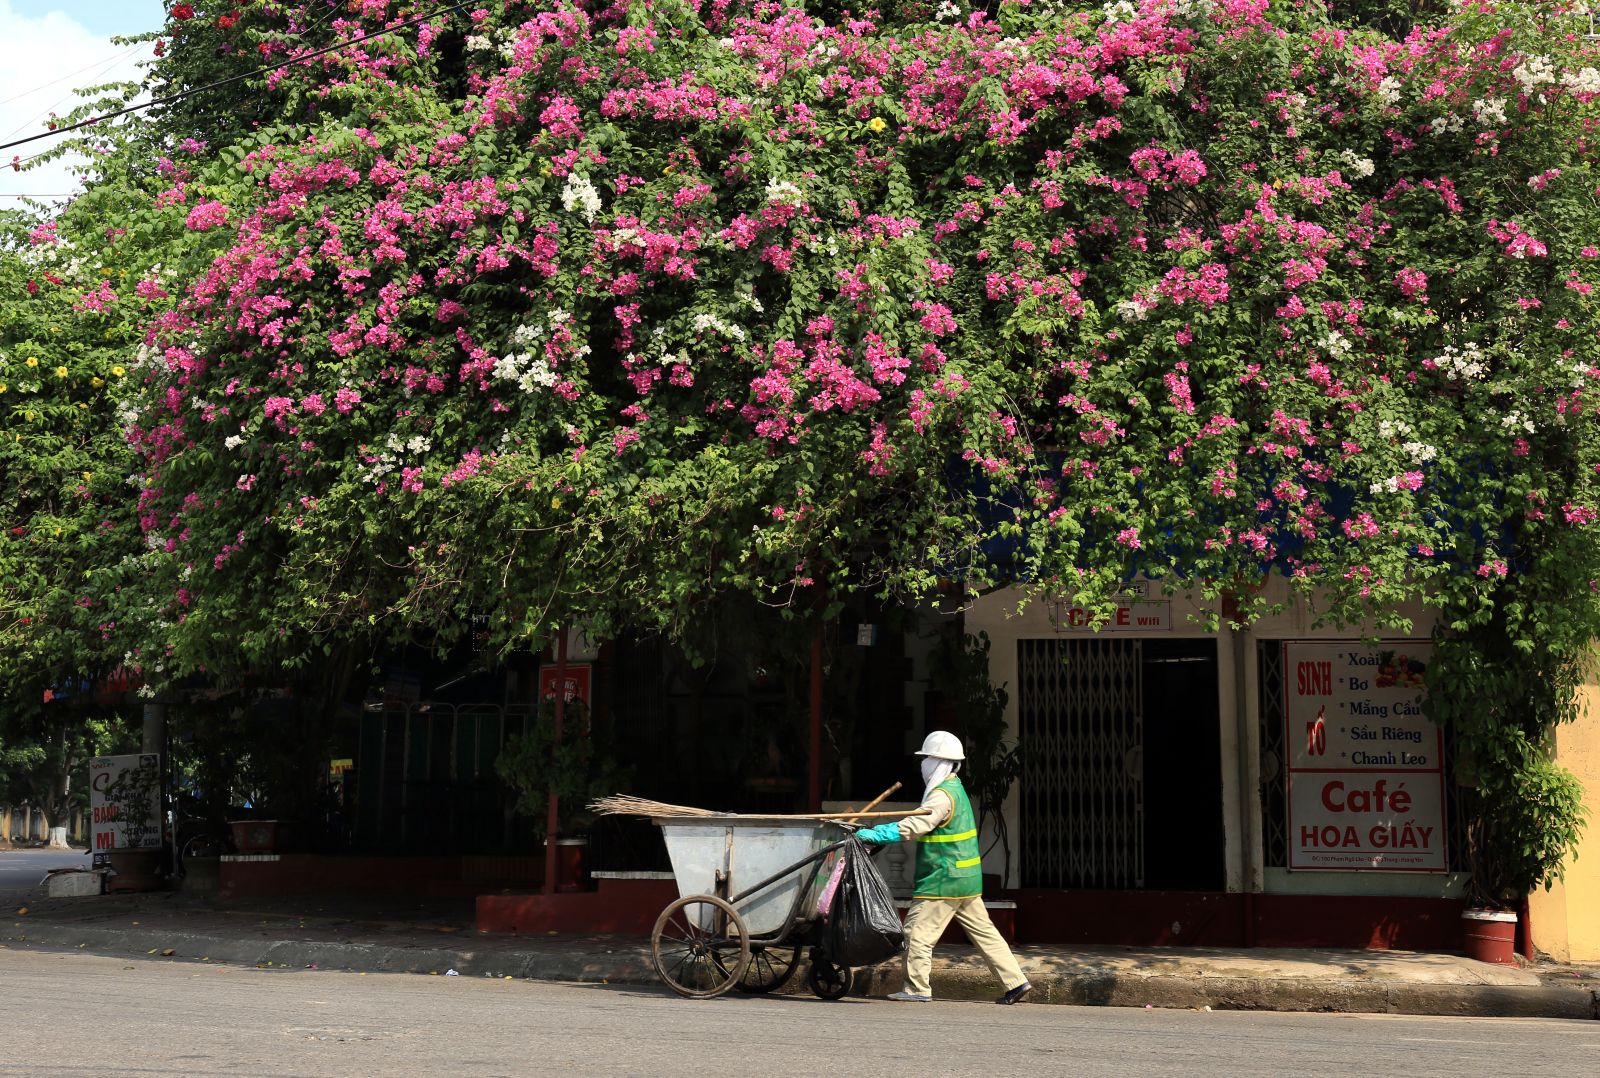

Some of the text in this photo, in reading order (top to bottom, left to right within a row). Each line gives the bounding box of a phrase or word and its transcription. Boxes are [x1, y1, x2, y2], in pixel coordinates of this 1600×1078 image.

[1347, 652, 1380, 667] Xoài
[1297, 662, 1332, 695] SINH
[1349, 677, 1368, 691] Bơ
[1392, 701, 1420, 716] Cầu
[1306, 704, 1327, 756] TỐ
[1351, 725, 1421, 743] Sầu Riêng
[1352, 751, 1427, 766] Chanh Leo
[1321, 780, 1412, 813] Café
[1301, 819, 1434, 849] HOA GIẤY
